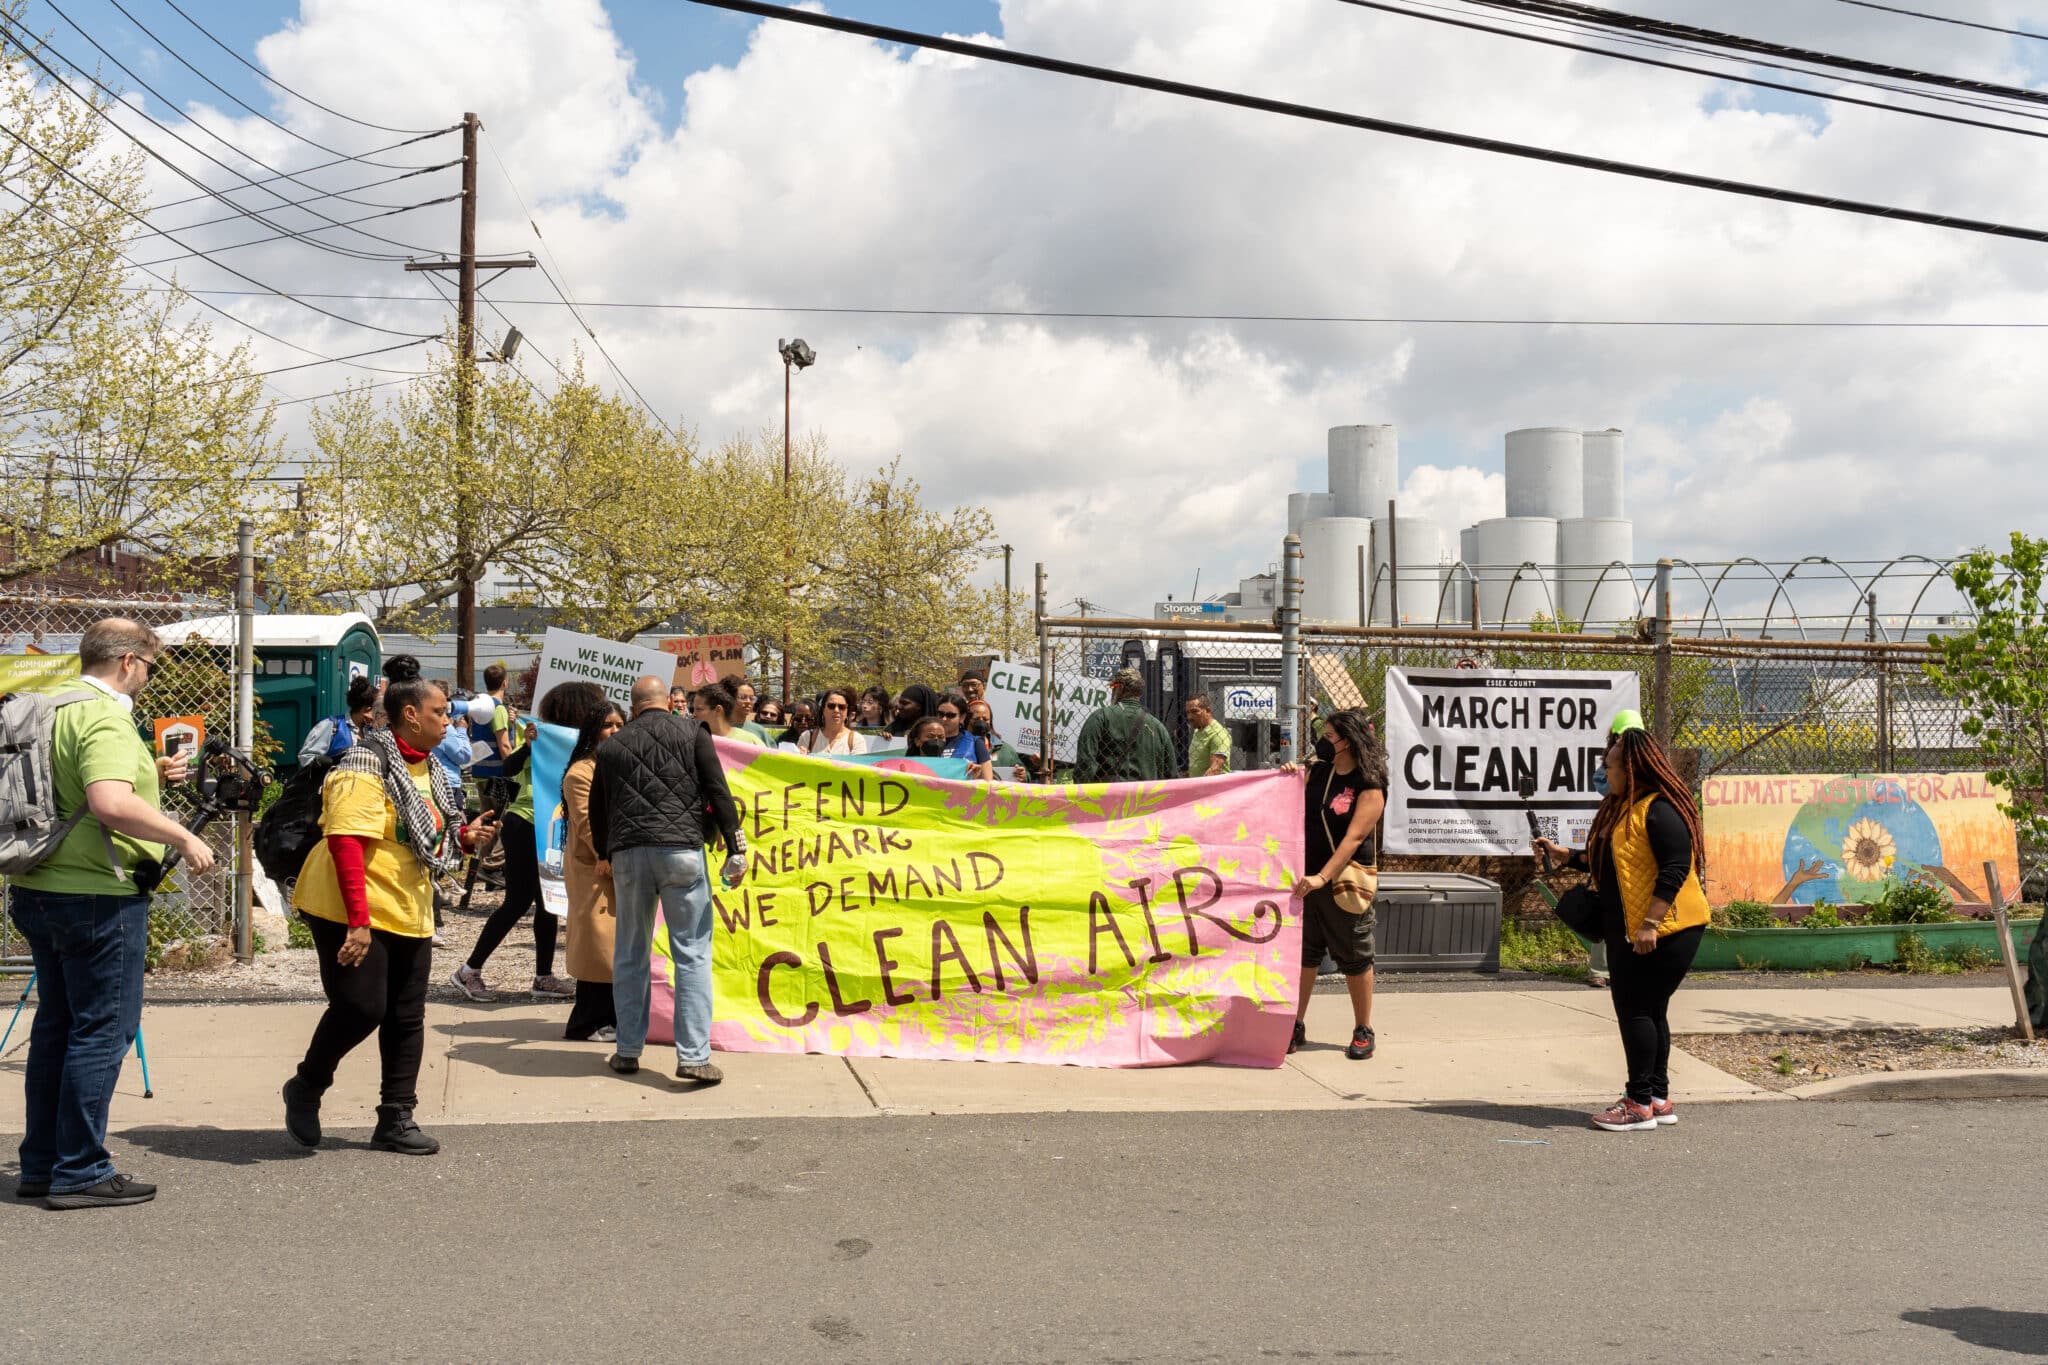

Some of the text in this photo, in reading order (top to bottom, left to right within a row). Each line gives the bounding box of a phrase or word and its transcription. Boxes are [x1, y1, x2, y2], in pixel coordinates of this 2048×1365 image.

[666, 635, 740, 653] STOP PVSC
[710, 648, 743, 661] PLAN
[14, 659, 68, 668] COMMUNITY
[550, 657, 640, 686] ENVIRONMEN
[578, 648, 644, 672] WE WANT
[45, 669, 75, 677] MARKET
[1509, 680, 1536, 688] COUNTY
[1069, 686, 1108, 708] AIR
[1233, 696, 1274, 708] United
[1422, 694, 1598, 730] MARCH FOR
[1403, 743, 1539, 792] CLEAN
[1704, 777, 1996, 807] CLIMATE JUSTICE FOR ALL
[752, 827, 913, 881] NEWARK
[712, 852, 1004, 934] WE DEMAND
[757, 866, 1283, 1027] CLEAN AIR
